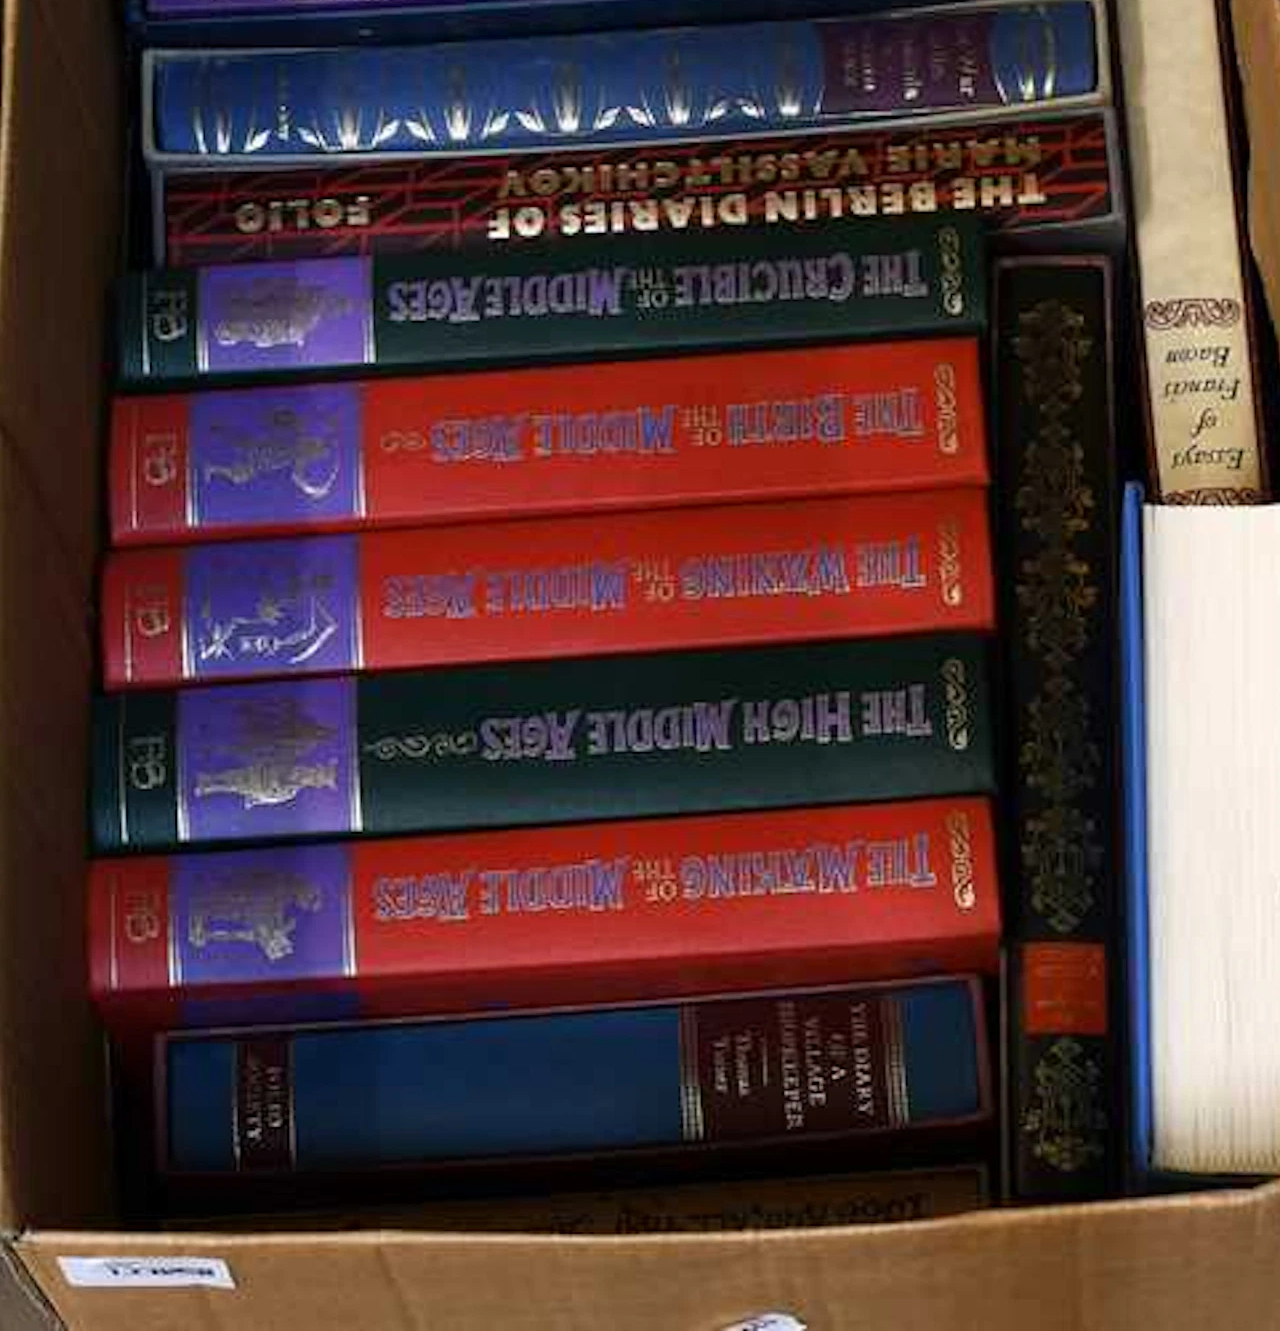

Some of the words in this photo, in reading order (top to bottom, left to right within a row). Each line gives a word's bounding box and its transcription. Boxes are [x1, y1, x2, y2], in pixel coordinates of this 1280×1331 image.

[560, 193, 749, 235] DIARIES
[765, 183, 938, 223] BERLIN
[952, 172, 1046, 209] THE
[487, 205, 538, 240] OF
[387, 275, 482, 322] AGES
[481, 265, 624, 318] MIDDLE
[674, 252, 855, 308] CRUCIBLE
[861, 250, 930, 298] THE
[1165, 342, 1232, 367] Bacon
[855, 388, 926, 435] THE
[1163, 374, 1241, 401] Francis
[534, 405, 677, 457] MIDDLE
[727, 395, 845, 446] BIRTH
[1190, 408, 1220, 438] of
[1170, 445, 1247, 471] Essays
[486, 560, 625, 613] MIDDLE
[856, 537, 926, 591] THE
[480, 709, 578, 761] AGES
[588, 698, 734, 755] MIDDLE
[743, 690, 852, 745] HIGH
[862, 684, 933, 737] THE
[479, 858, 625, 915] MIDDLE
[682, 846, 857, 901] MAKING
[866, 833, 937, 888] THE
[804, 1016, 827, 1107] VILLAGE
[853, 1046, 875, 1117] DIARY
